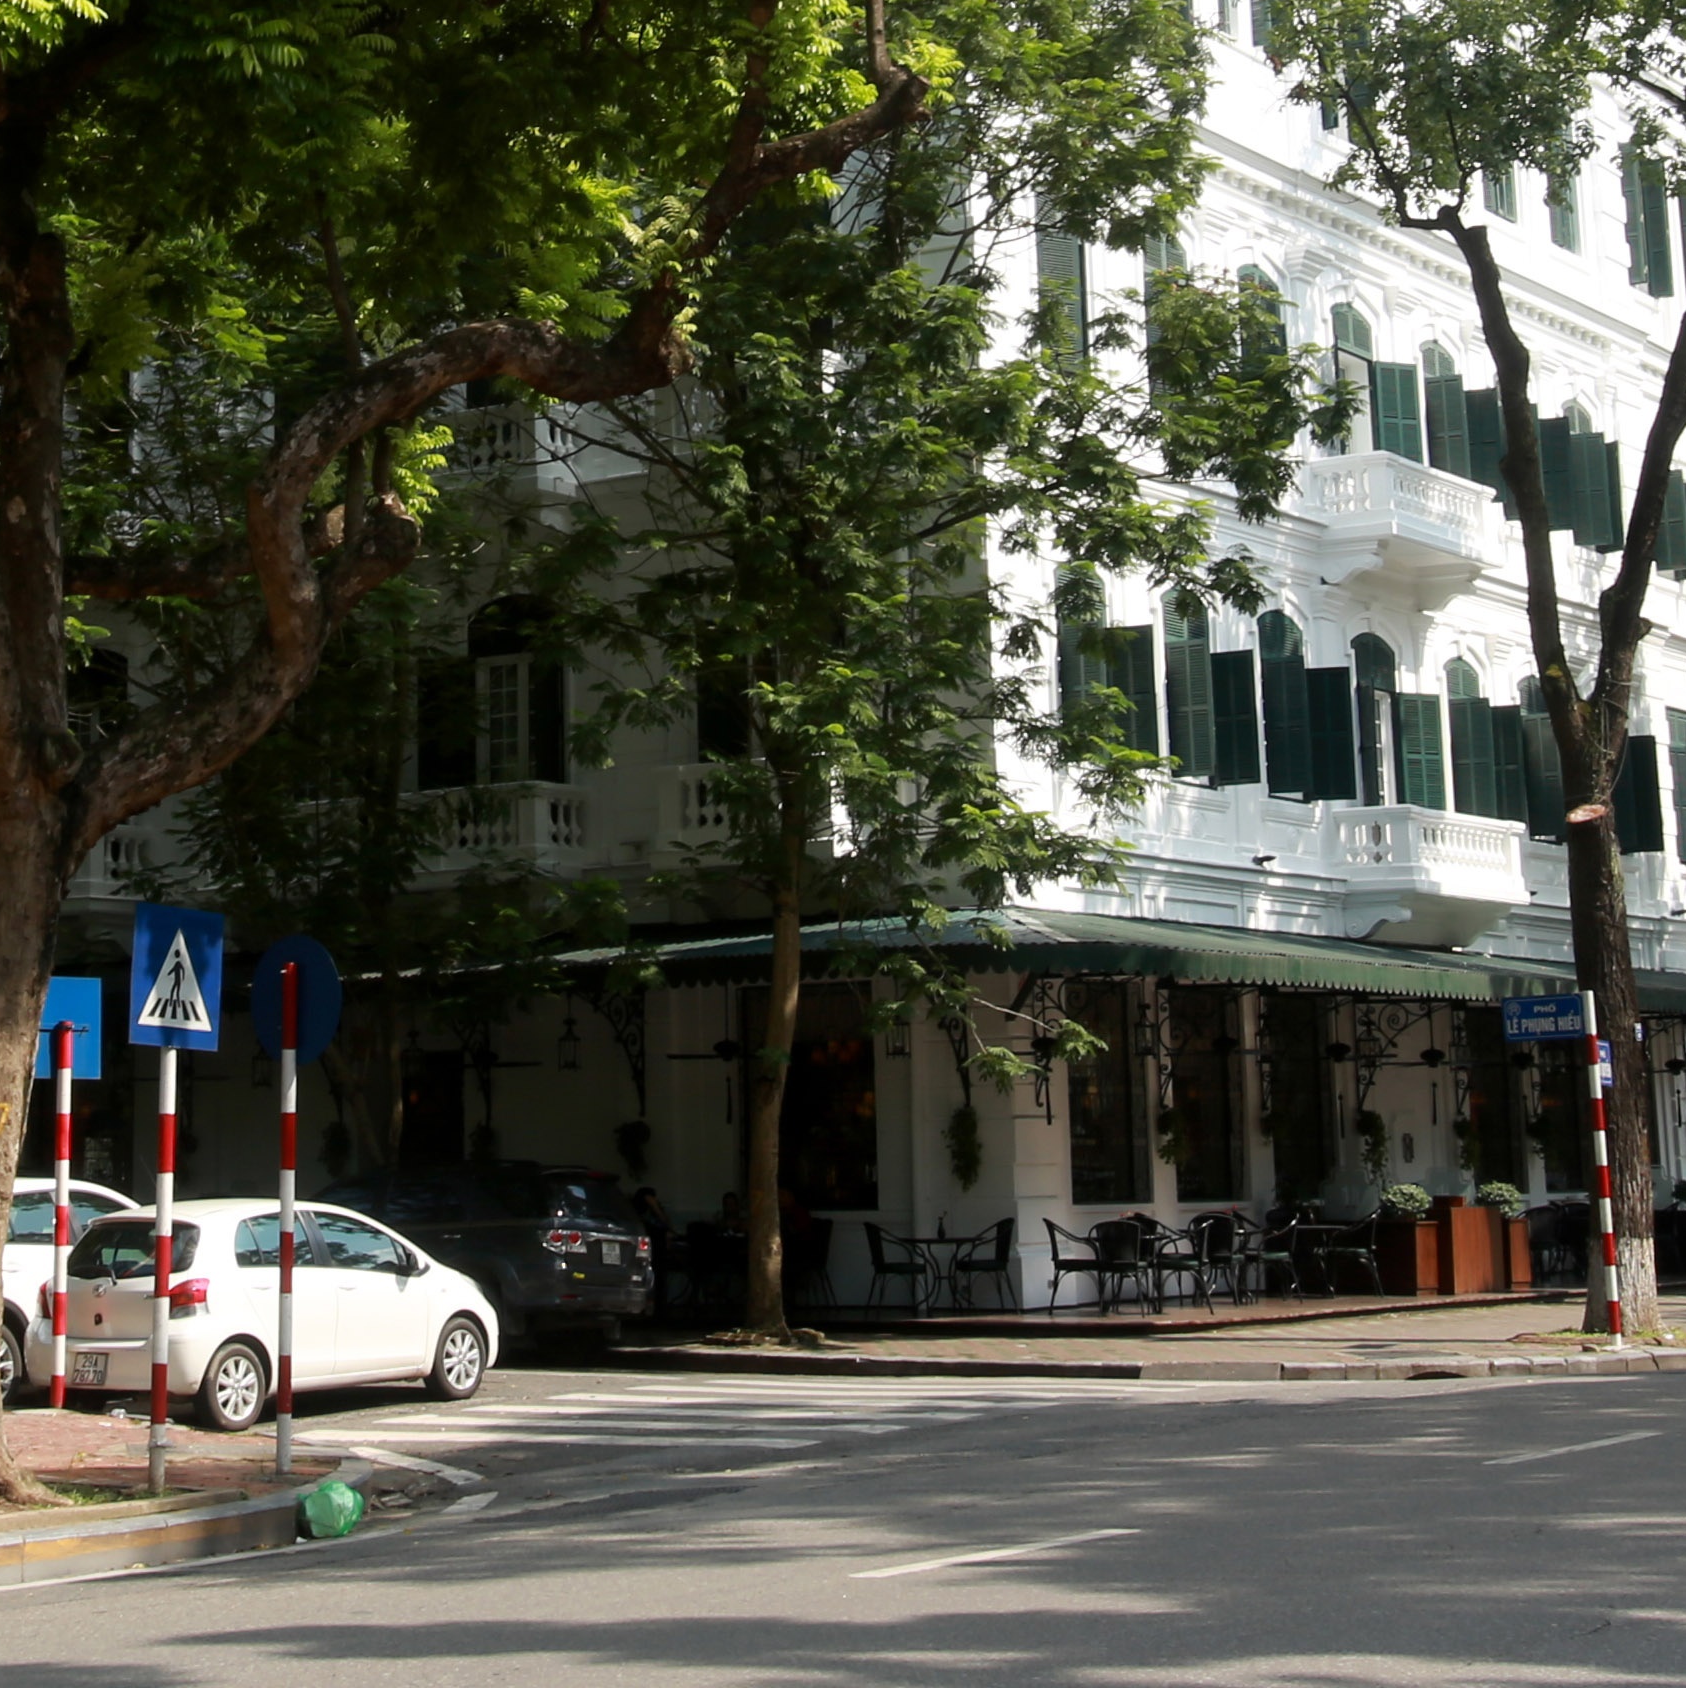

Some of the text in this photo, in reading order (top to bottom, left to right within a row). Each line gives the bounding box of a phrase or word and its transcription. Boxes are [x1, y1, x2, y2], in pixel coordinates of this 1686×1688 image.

[1533, 1002, 1557, 1013] PHỐ
[1506, 1016, 1519, 1034] LÊ
[1521, 1016, 1556, 1036] PHỤNG
[82, 1354, 99, 1369] 29A
